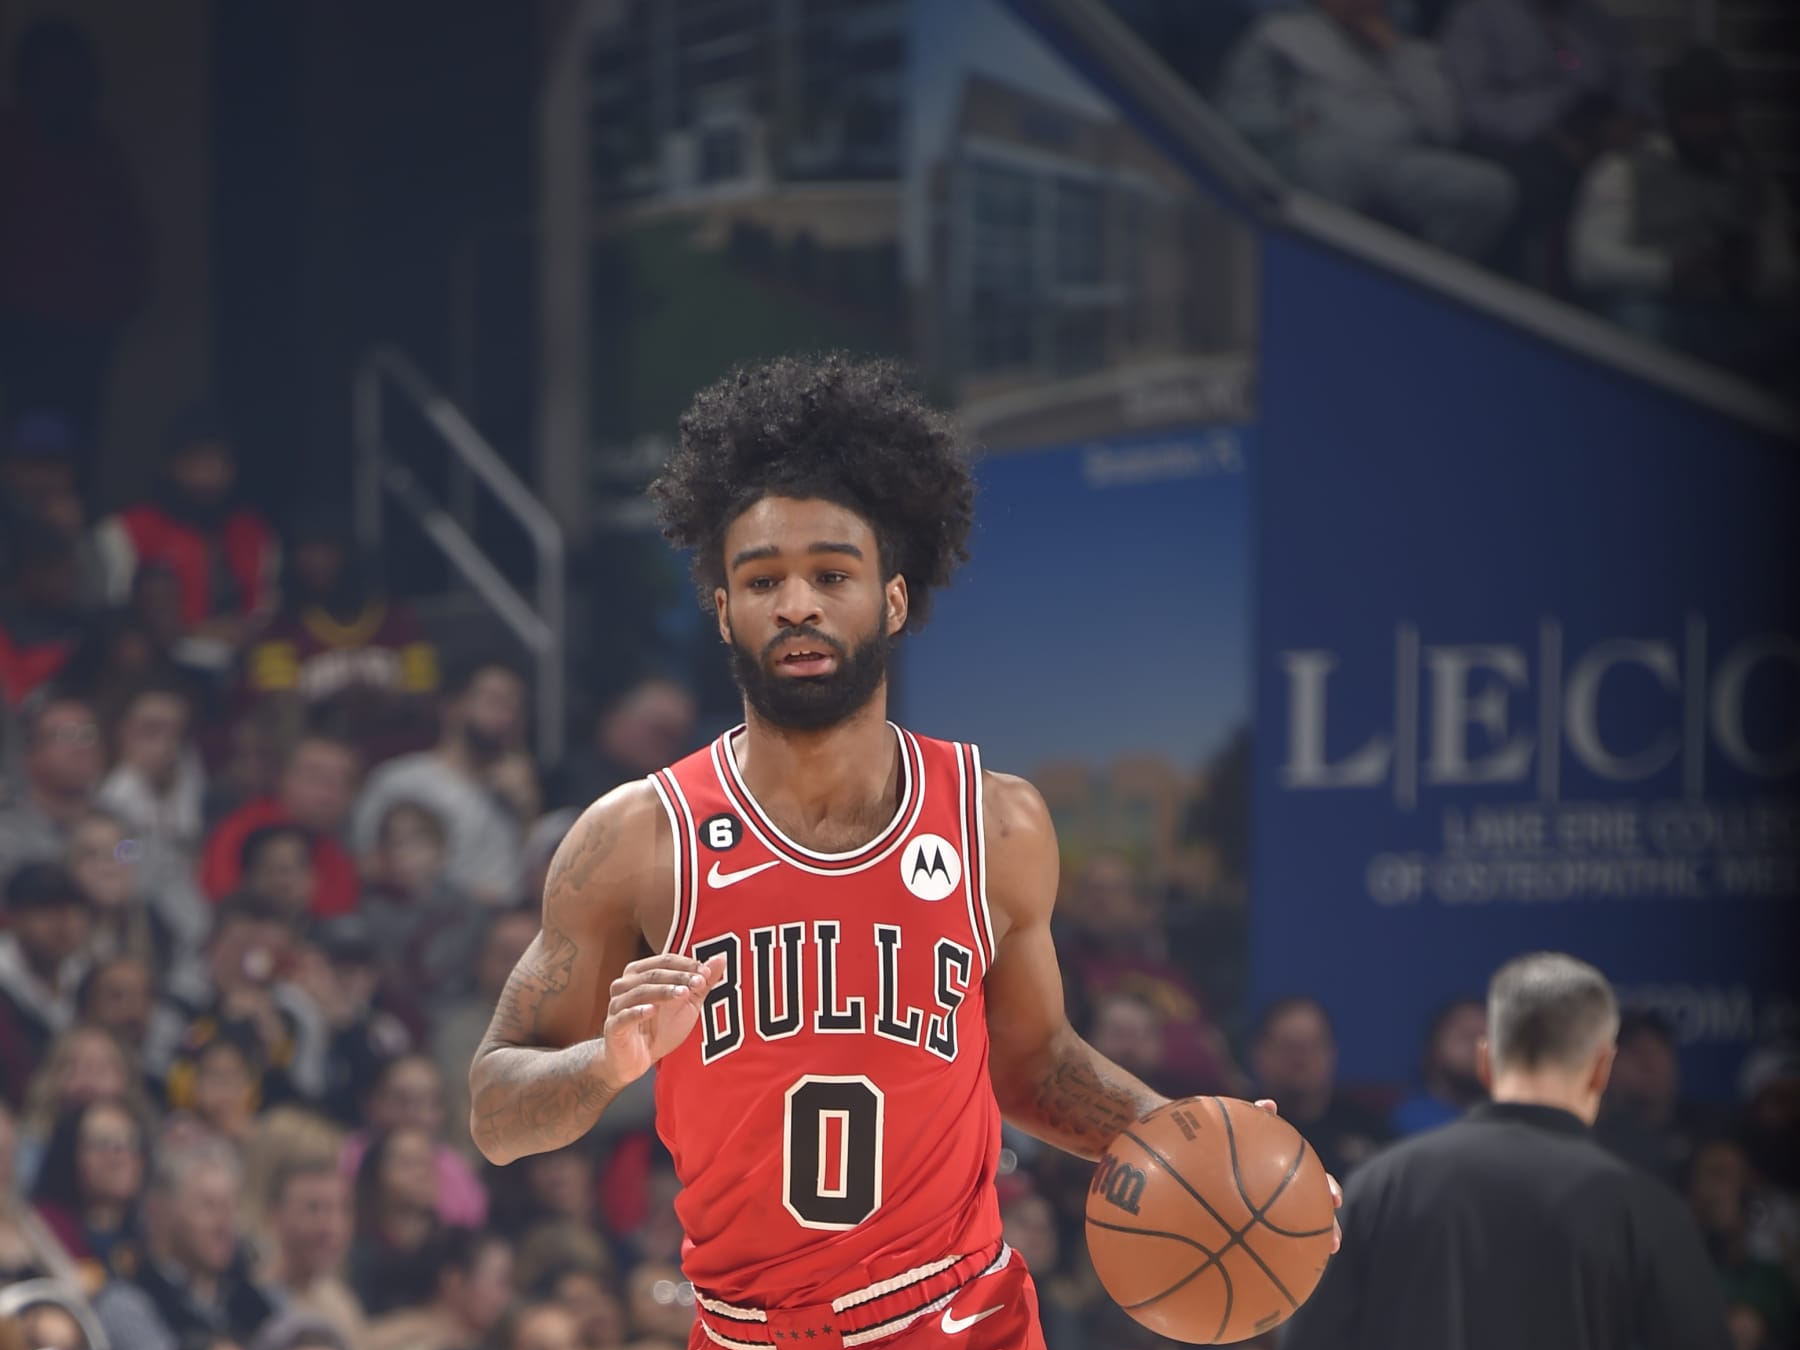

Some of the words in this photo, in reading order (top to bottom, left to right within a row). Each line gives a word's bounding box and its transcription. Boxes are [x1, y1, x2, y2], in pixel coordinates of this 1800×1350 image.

[708, 816, 734, 849] 6
[692, 919, 974, 1065] BULLS
[783, 1073, 885, 1232] 0
